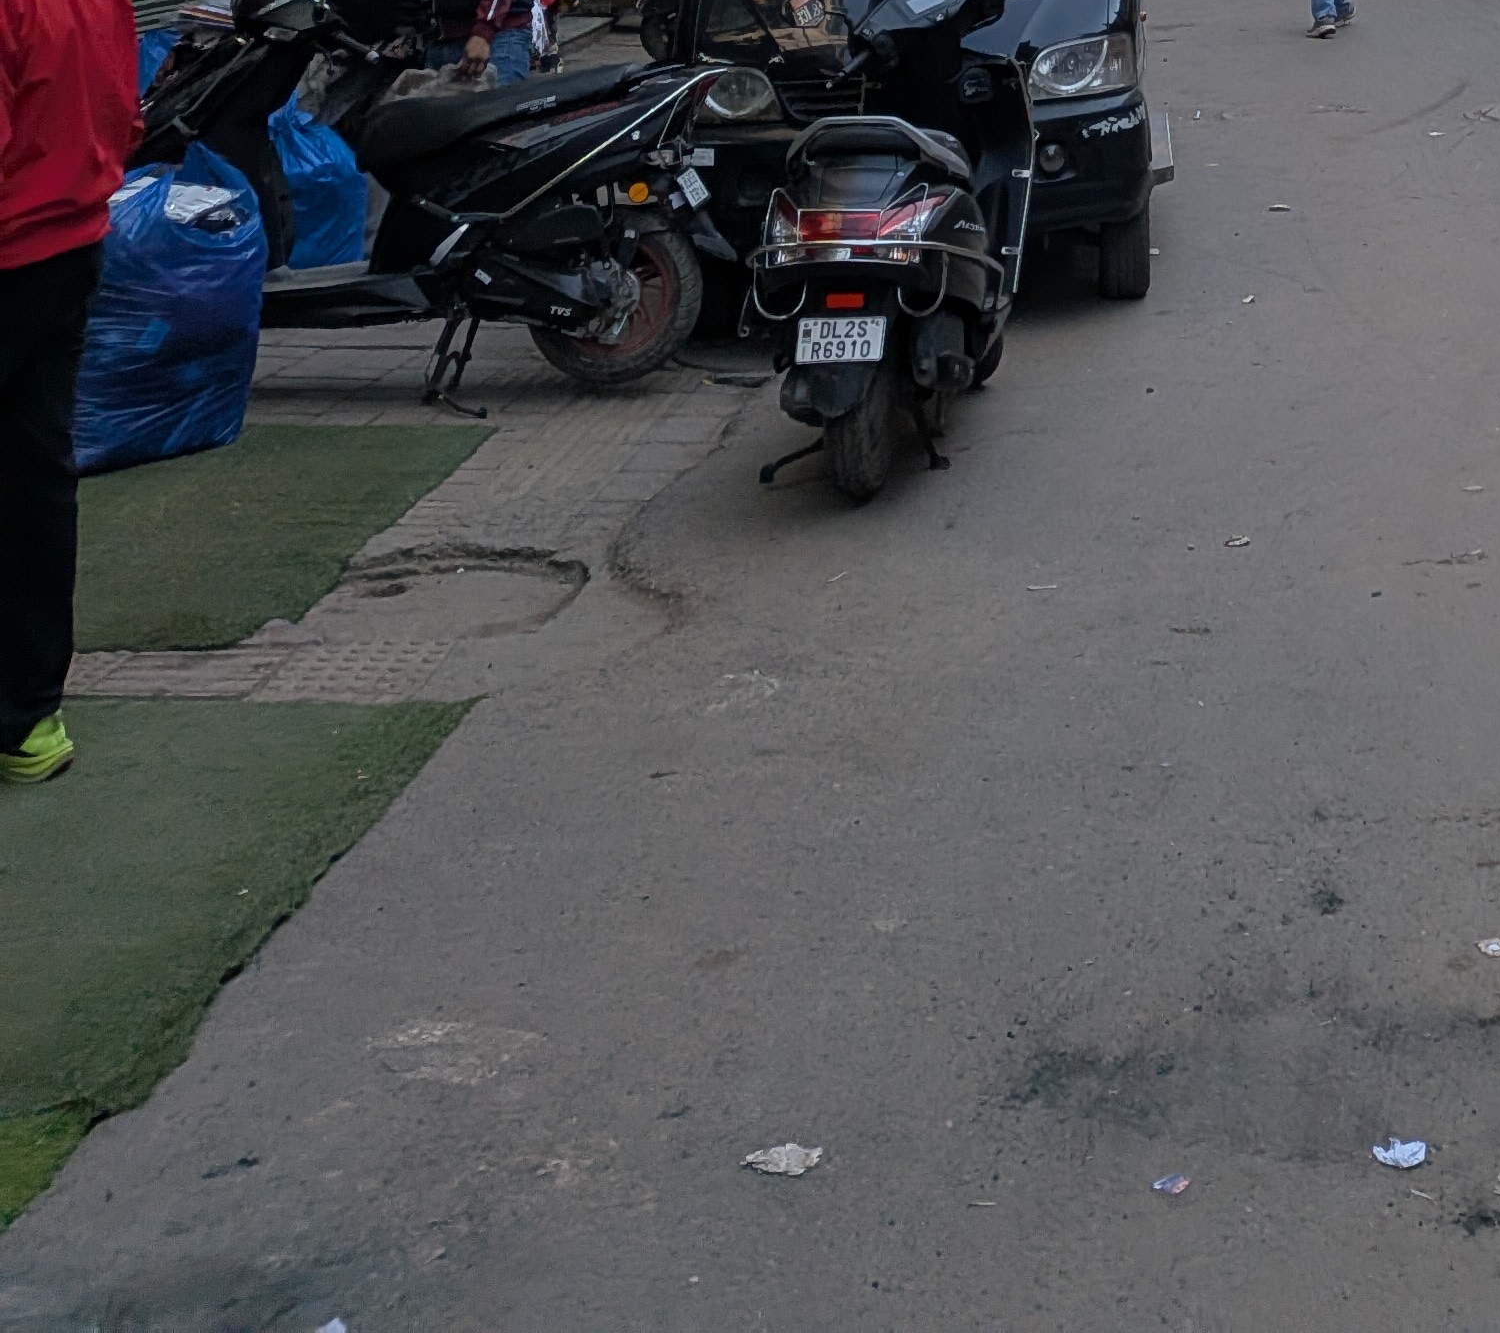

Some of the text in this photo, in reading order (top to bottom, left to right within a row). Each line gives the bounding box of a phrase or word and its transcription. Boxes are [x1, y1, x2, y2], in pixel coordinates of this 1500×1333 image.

[550, 305, 573, 318] TVS
[818, 320, 869, 339] DL2S
[810, 340, 872, 360] R6910
